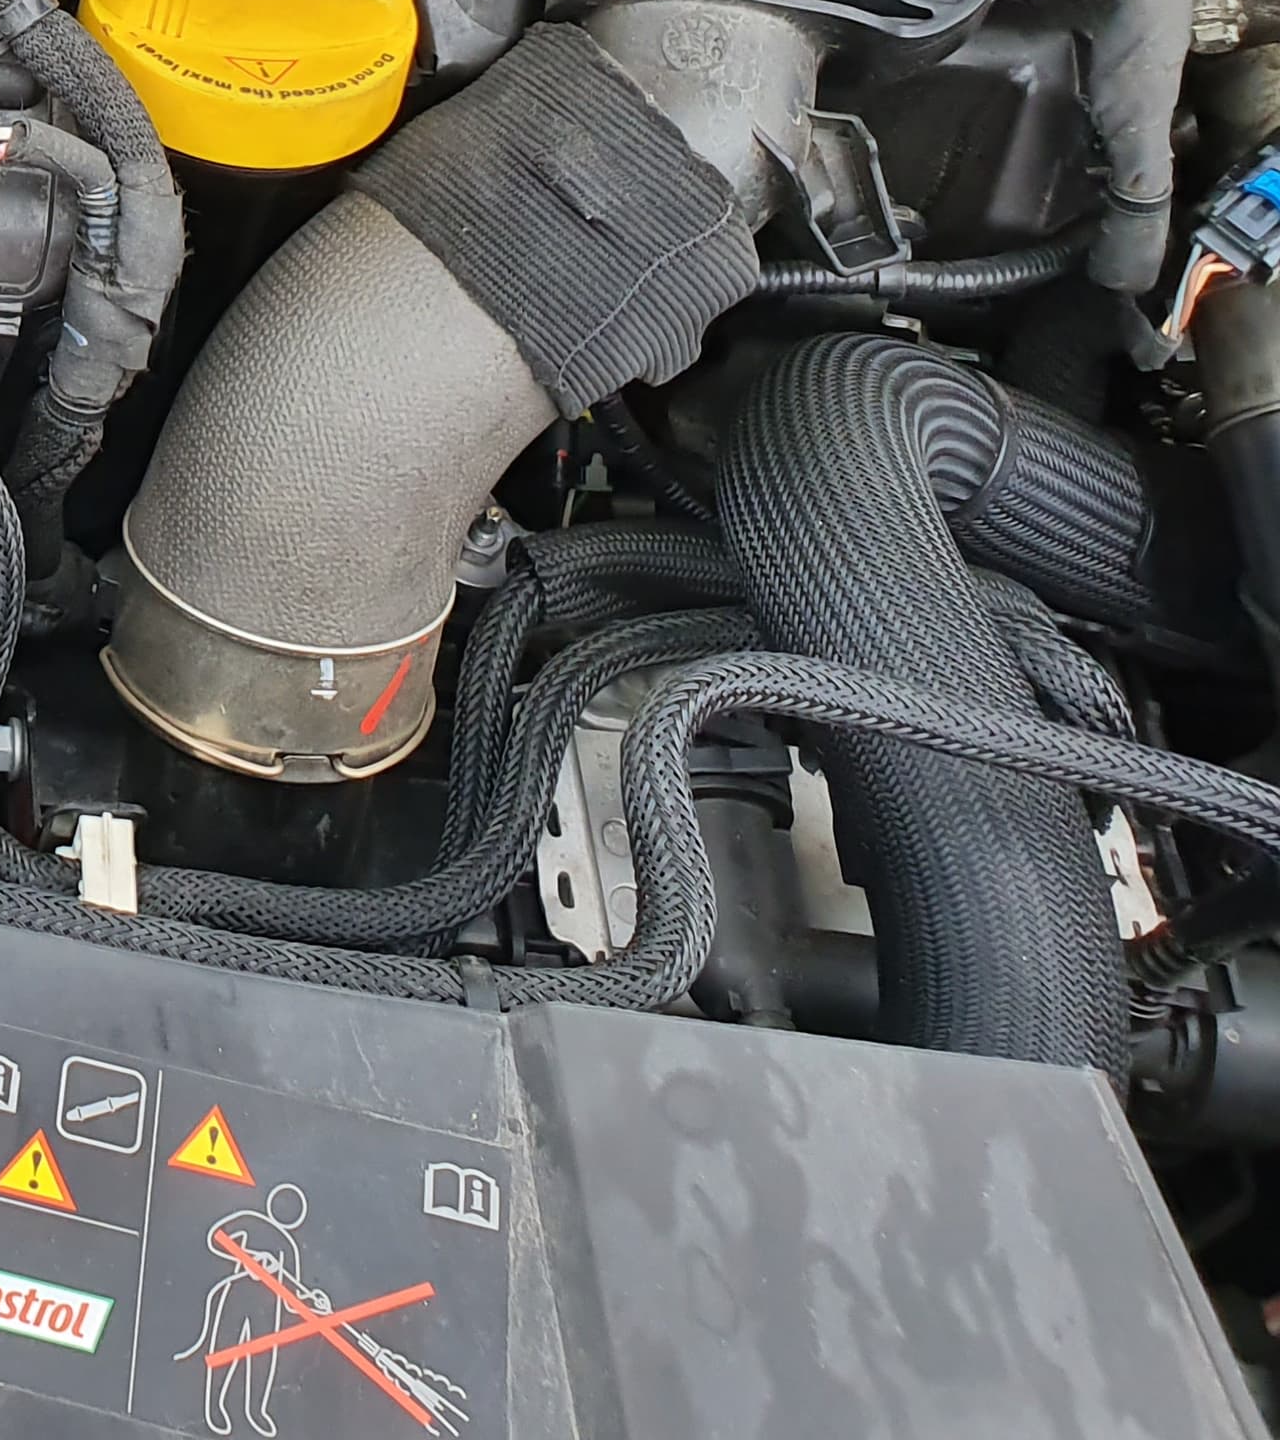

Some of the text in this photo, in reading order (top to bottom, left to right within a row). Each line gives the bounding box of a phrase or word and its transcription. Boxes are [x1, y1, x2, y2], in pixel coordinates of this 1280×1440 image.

[135, 41, 396, 101] Do not exceed the maxi level
